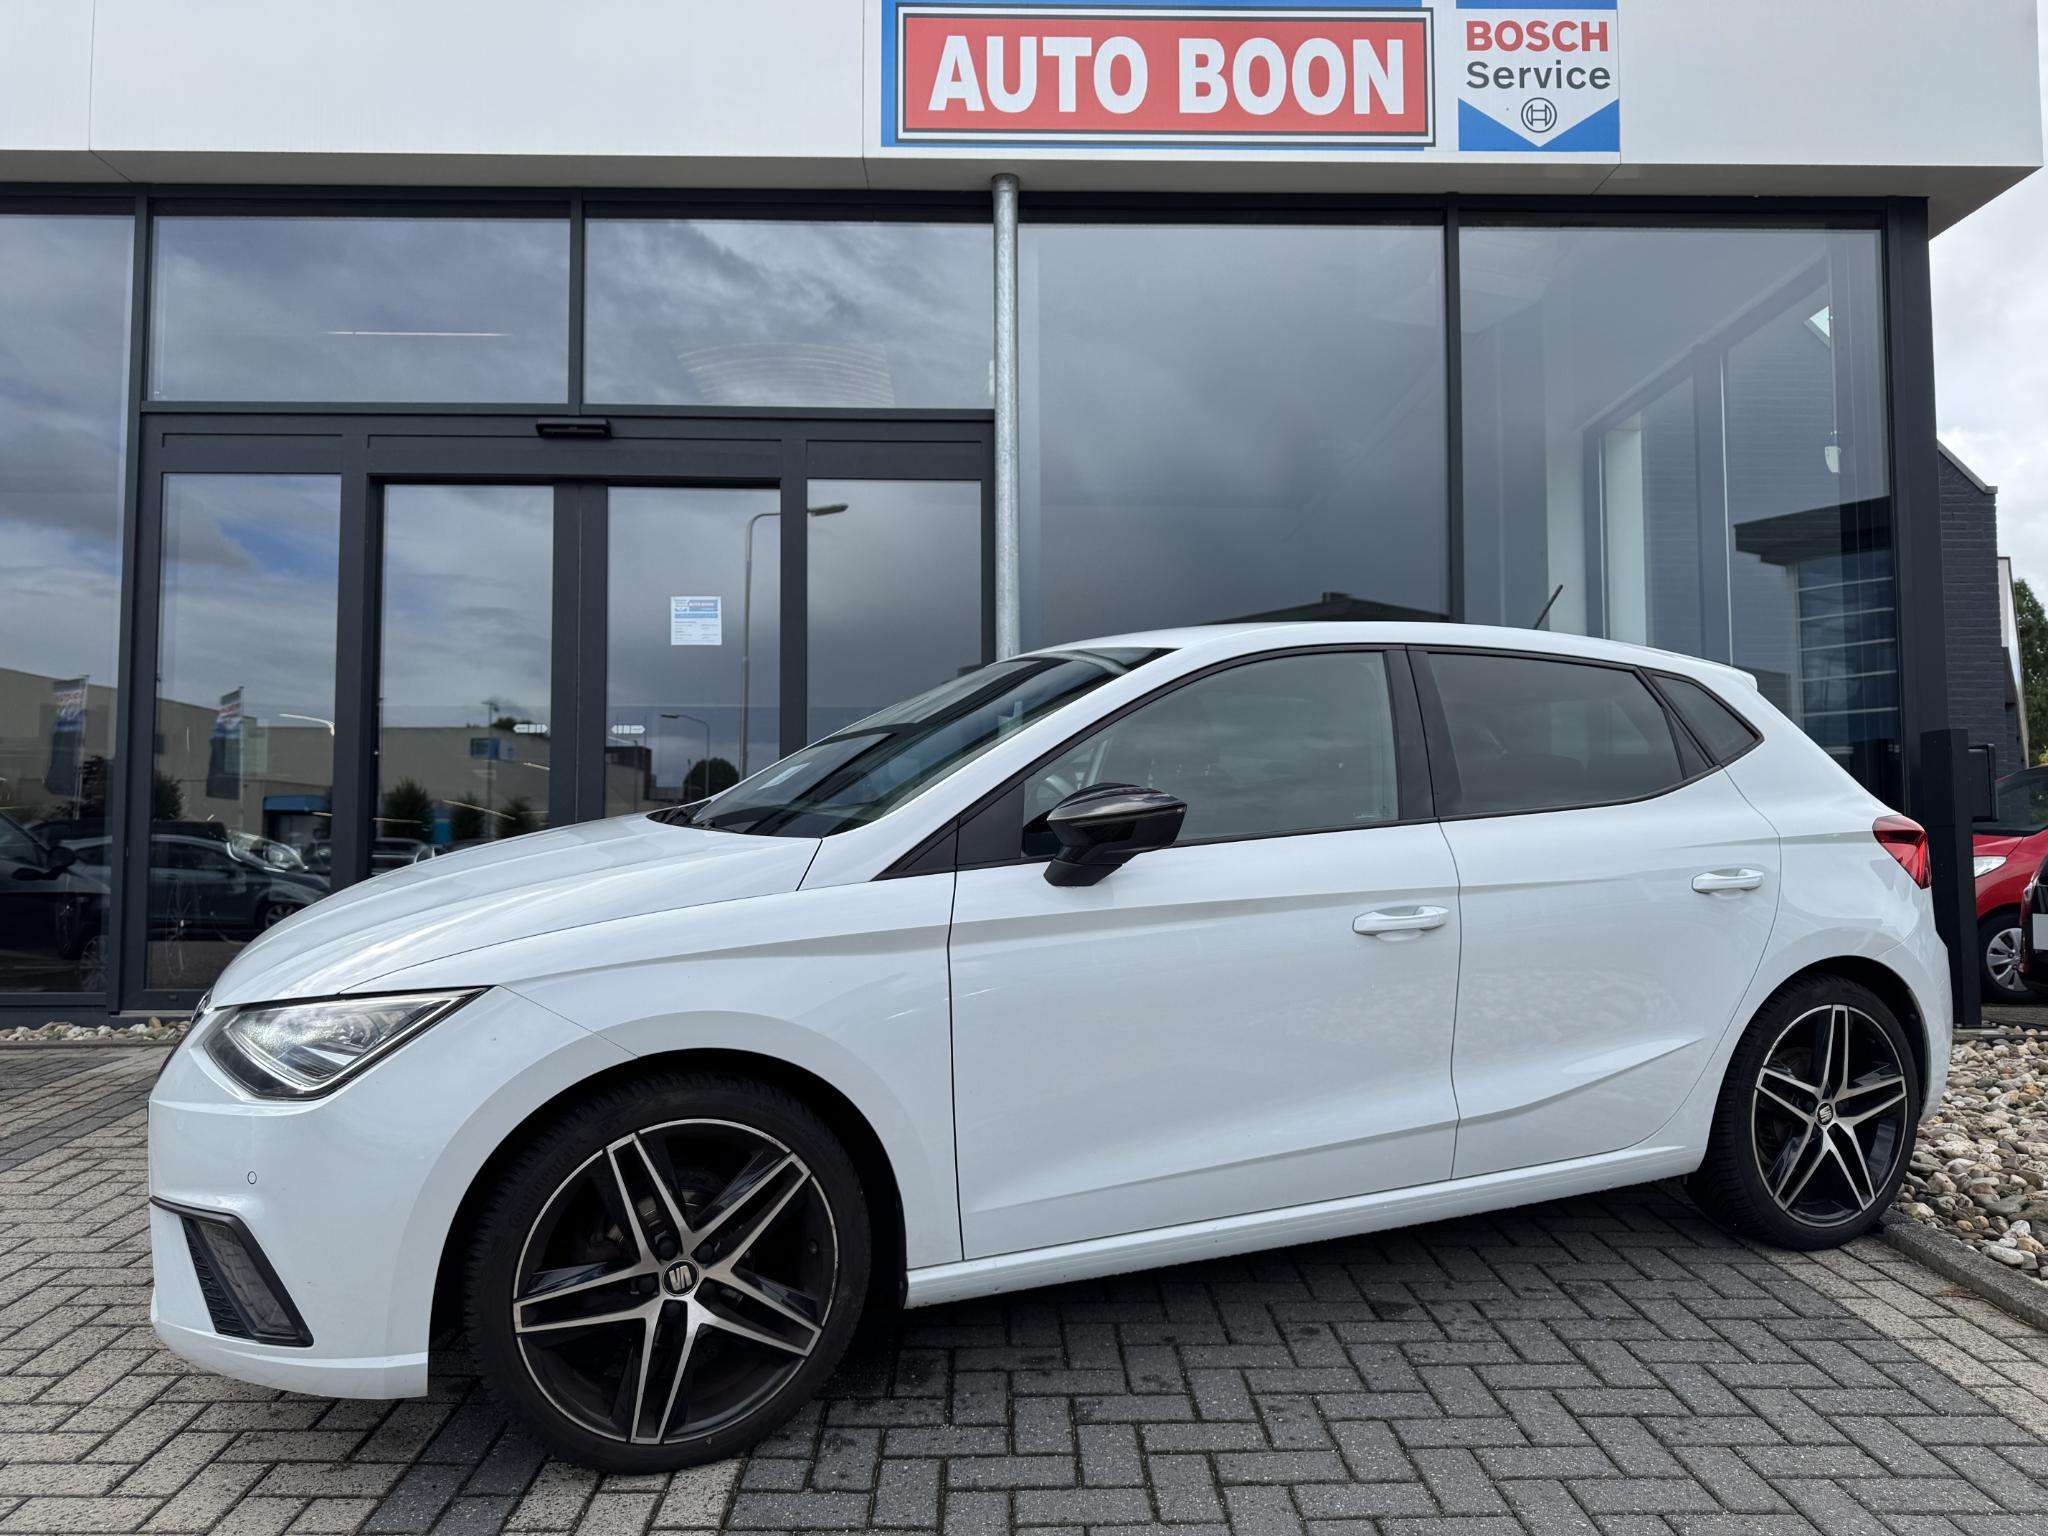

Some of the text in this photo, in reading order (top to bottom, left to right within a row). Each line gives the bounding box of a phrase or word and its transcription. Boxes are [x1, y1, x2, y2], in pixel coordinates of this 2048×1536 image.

[1466, 20, 1608, 52] BOSCH
[928, 35, 1405, 116] AUTO BOON
[1466, 59, 1611, 90] Service
